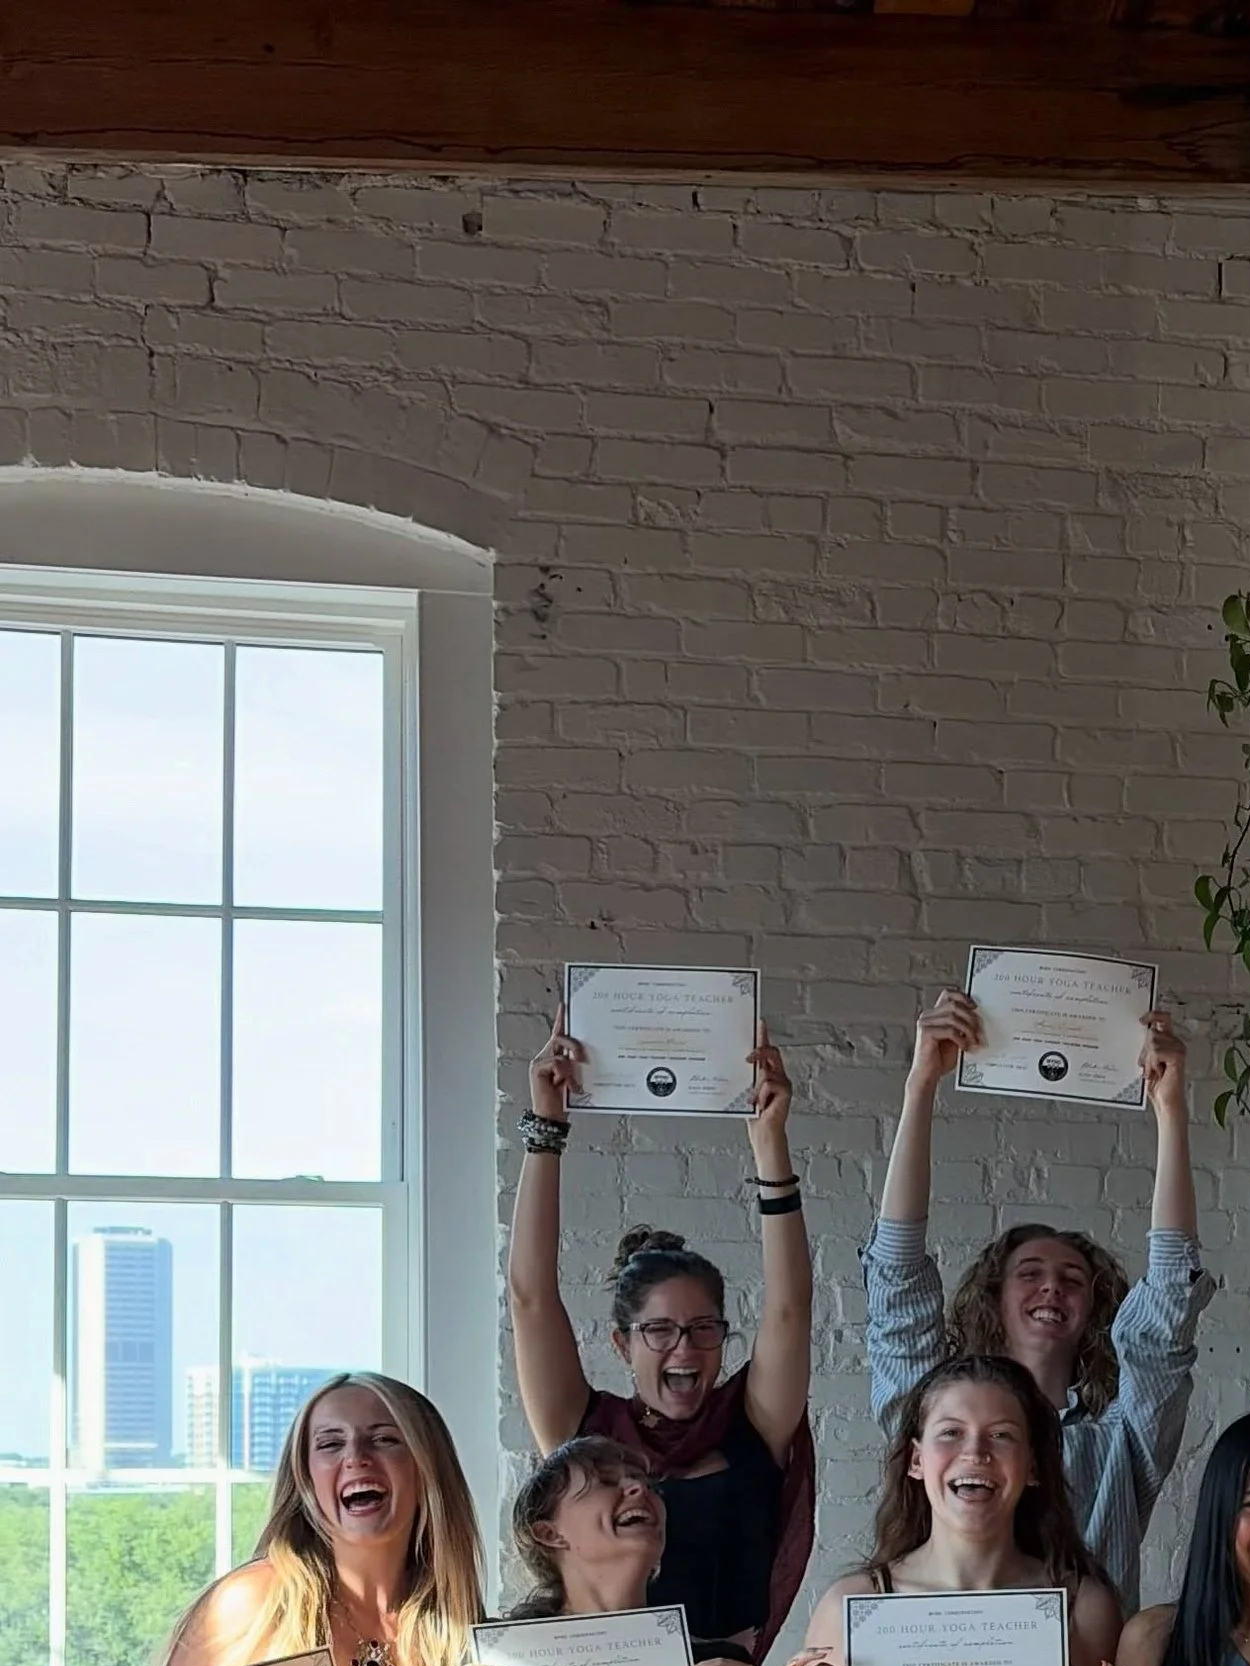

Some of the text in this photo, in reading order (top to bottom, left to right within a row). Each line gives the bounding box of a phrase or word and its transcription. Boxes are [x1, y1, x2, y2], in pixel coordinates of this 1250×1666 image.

[1013, 974, 1044, 985] HOUR
[1048, 978, 1079, 989] YOGA
[1084, 981, 1132, 995] TEACHER
[683, 993, 733, 1004] TEACHER
[876, 1620, 1038, 1635] 200 HOUR YOGA TEACHER
[528, 1646, 564, 1659] HOUR
[568, 1642, 602, 1655] YOGA
[606, 1636, 662, 1651] TEACHER
